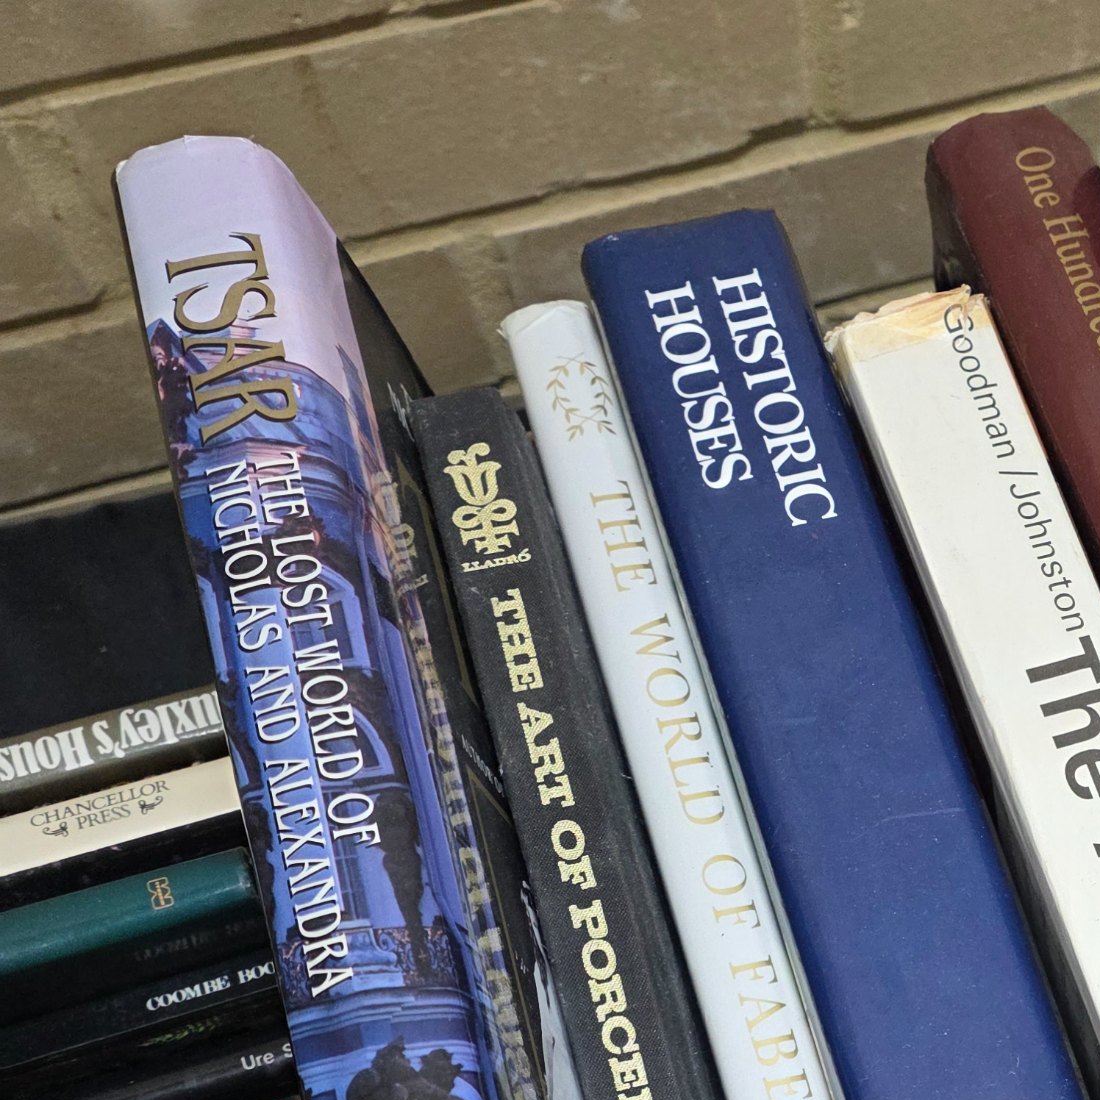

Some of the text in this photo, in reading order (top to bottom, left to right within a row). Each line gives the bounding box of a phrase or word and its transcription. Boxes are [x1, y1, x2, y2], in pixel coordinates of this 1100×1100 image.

[1015, 146, 1060, 208] One
[164, 231, 298, 446] TSAR
[644, 280, 754, 490] HOUSES
[711, 267, 838, 527] HISTORIC
[0, 690, 226, 782] uxley's Hous
[205, 457, 354, 999] NICHOLAS AND ALEXANDRA
[253, 451, 381, 847] THE LOST WORLD OF
[490, 588, 544, 693] THE
[517, 702, 576, 808] ART
[550, 819, 598, 891] OF
[590, 480, 658, 593] THE
[629, 612, 726, 826] WORLD
[702, 853, 762, 930] OF
[30, 780, 171, 827] CHANCELLOR
[76, 804, 132, 831] PRESS
[146, 961, 276, 1011] COOMBE BOO
[240, 1051, 275, 1070] Ure
